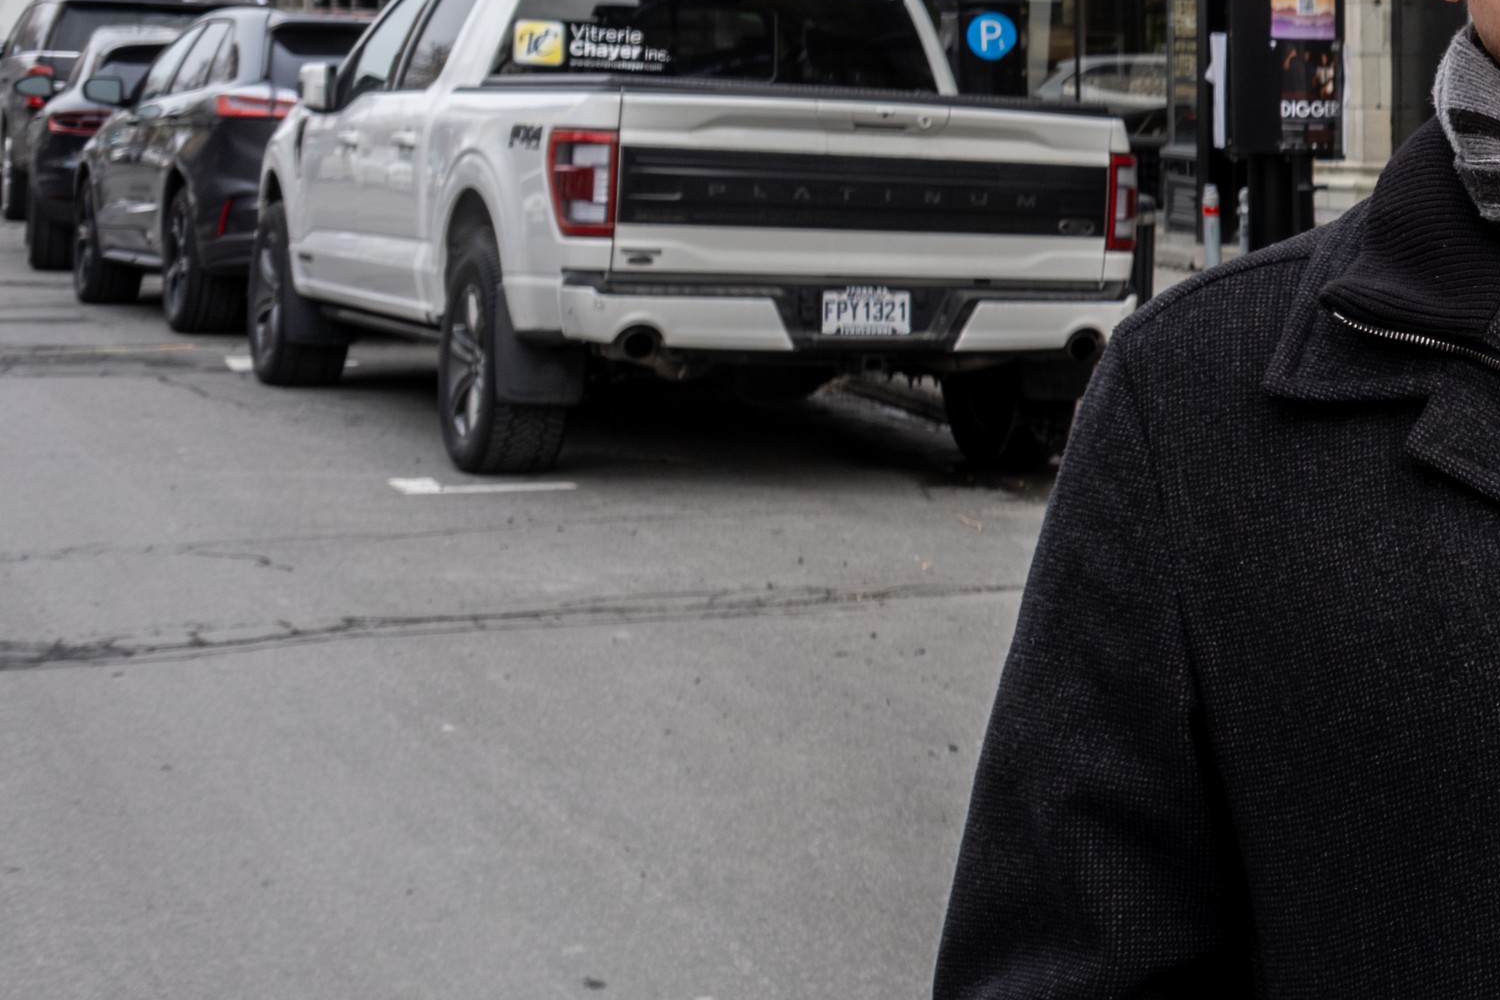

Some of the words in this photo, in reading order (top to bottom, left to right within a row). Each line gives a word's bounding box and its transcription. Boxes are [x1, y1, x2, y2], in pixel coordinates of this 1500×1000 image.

[570, 23, 644, 45] Vitrerie
[569, 40, 643, 61] Chayer
[708, 184, 1037, 208] PLATINUM
[824, 300, 906, 322] FPY1321
